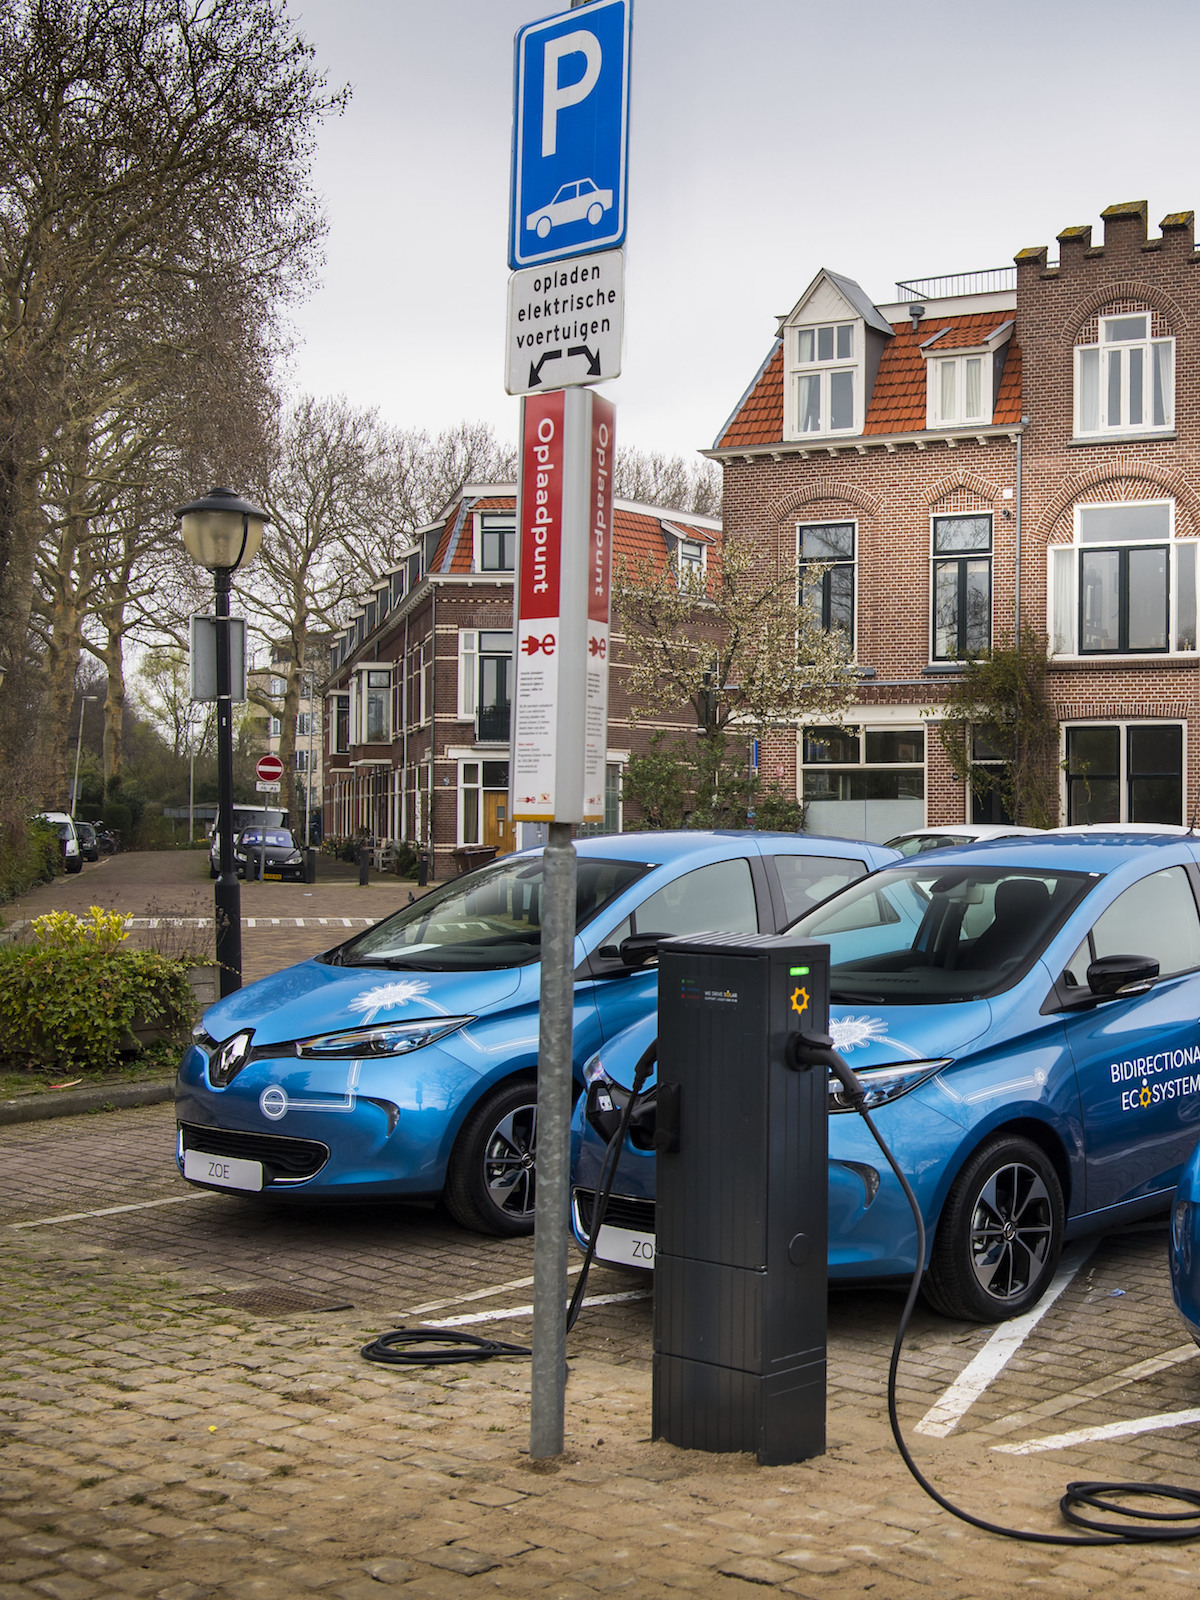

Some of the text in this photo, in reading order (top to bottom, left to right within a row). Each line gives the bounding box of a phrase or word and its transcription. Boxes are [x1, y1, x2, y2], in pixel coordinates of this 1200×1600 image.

[542, 29, 602, 158] P
[533, 265, 600, 294] opladen
[518, 288, 616, 322] elektrische
[516, 318, 610, 349] voertuigen
[531, 417, 555, 594] Oplaadpunt
[594, 422, 609, 597] Oplaadpunt
[1122, 1074, 1200, 1111] ECOSYSTEM
[208, 1161, 230, 1179] ZOE
[632, 1240, 654, 1260] ZO
